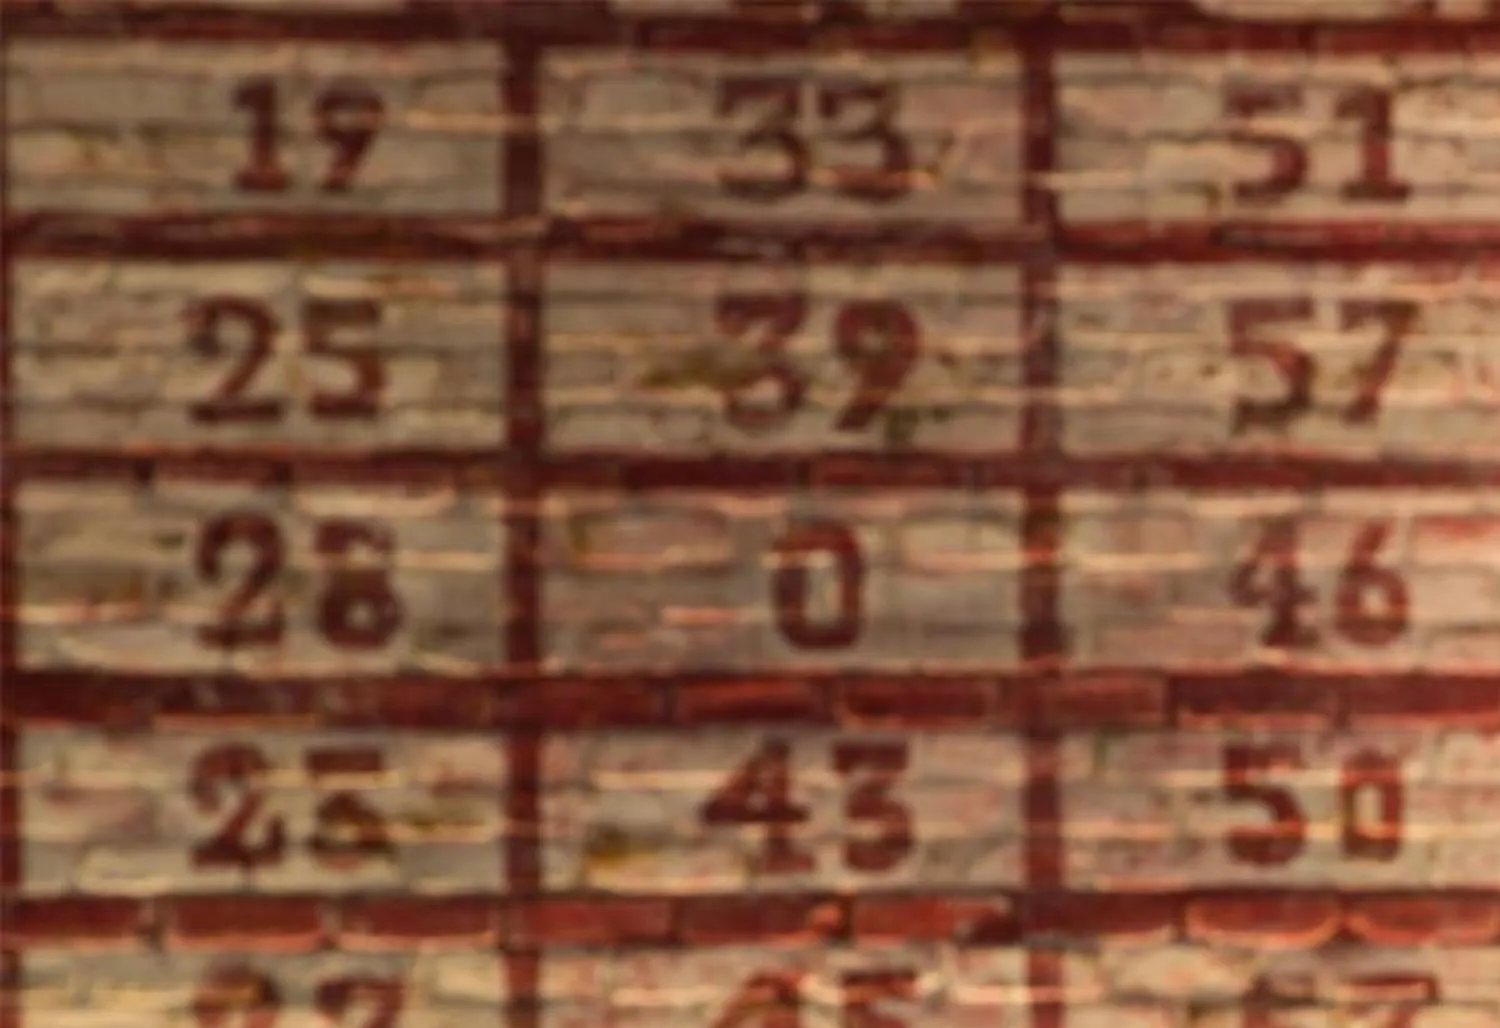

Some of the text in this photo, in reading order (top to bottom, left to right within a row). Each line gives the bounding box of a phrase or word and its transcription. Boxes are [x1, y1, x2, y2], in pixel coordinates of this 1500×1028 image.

[229, 78, 386, 193] 19
[715, 78, 912, 200] 33
[1222, 84, 1410, 200] 51
[184, 296, 388, 424] 25
[714, 293, 922, 432] 39
[1228, 297, 1414, 430] 57
[768, 518, 868, 651] 0
[1227, 516, 1411, 649] 46
[699, 738, 917, 874] 43
[1222, 744, 1404, 868] 50
